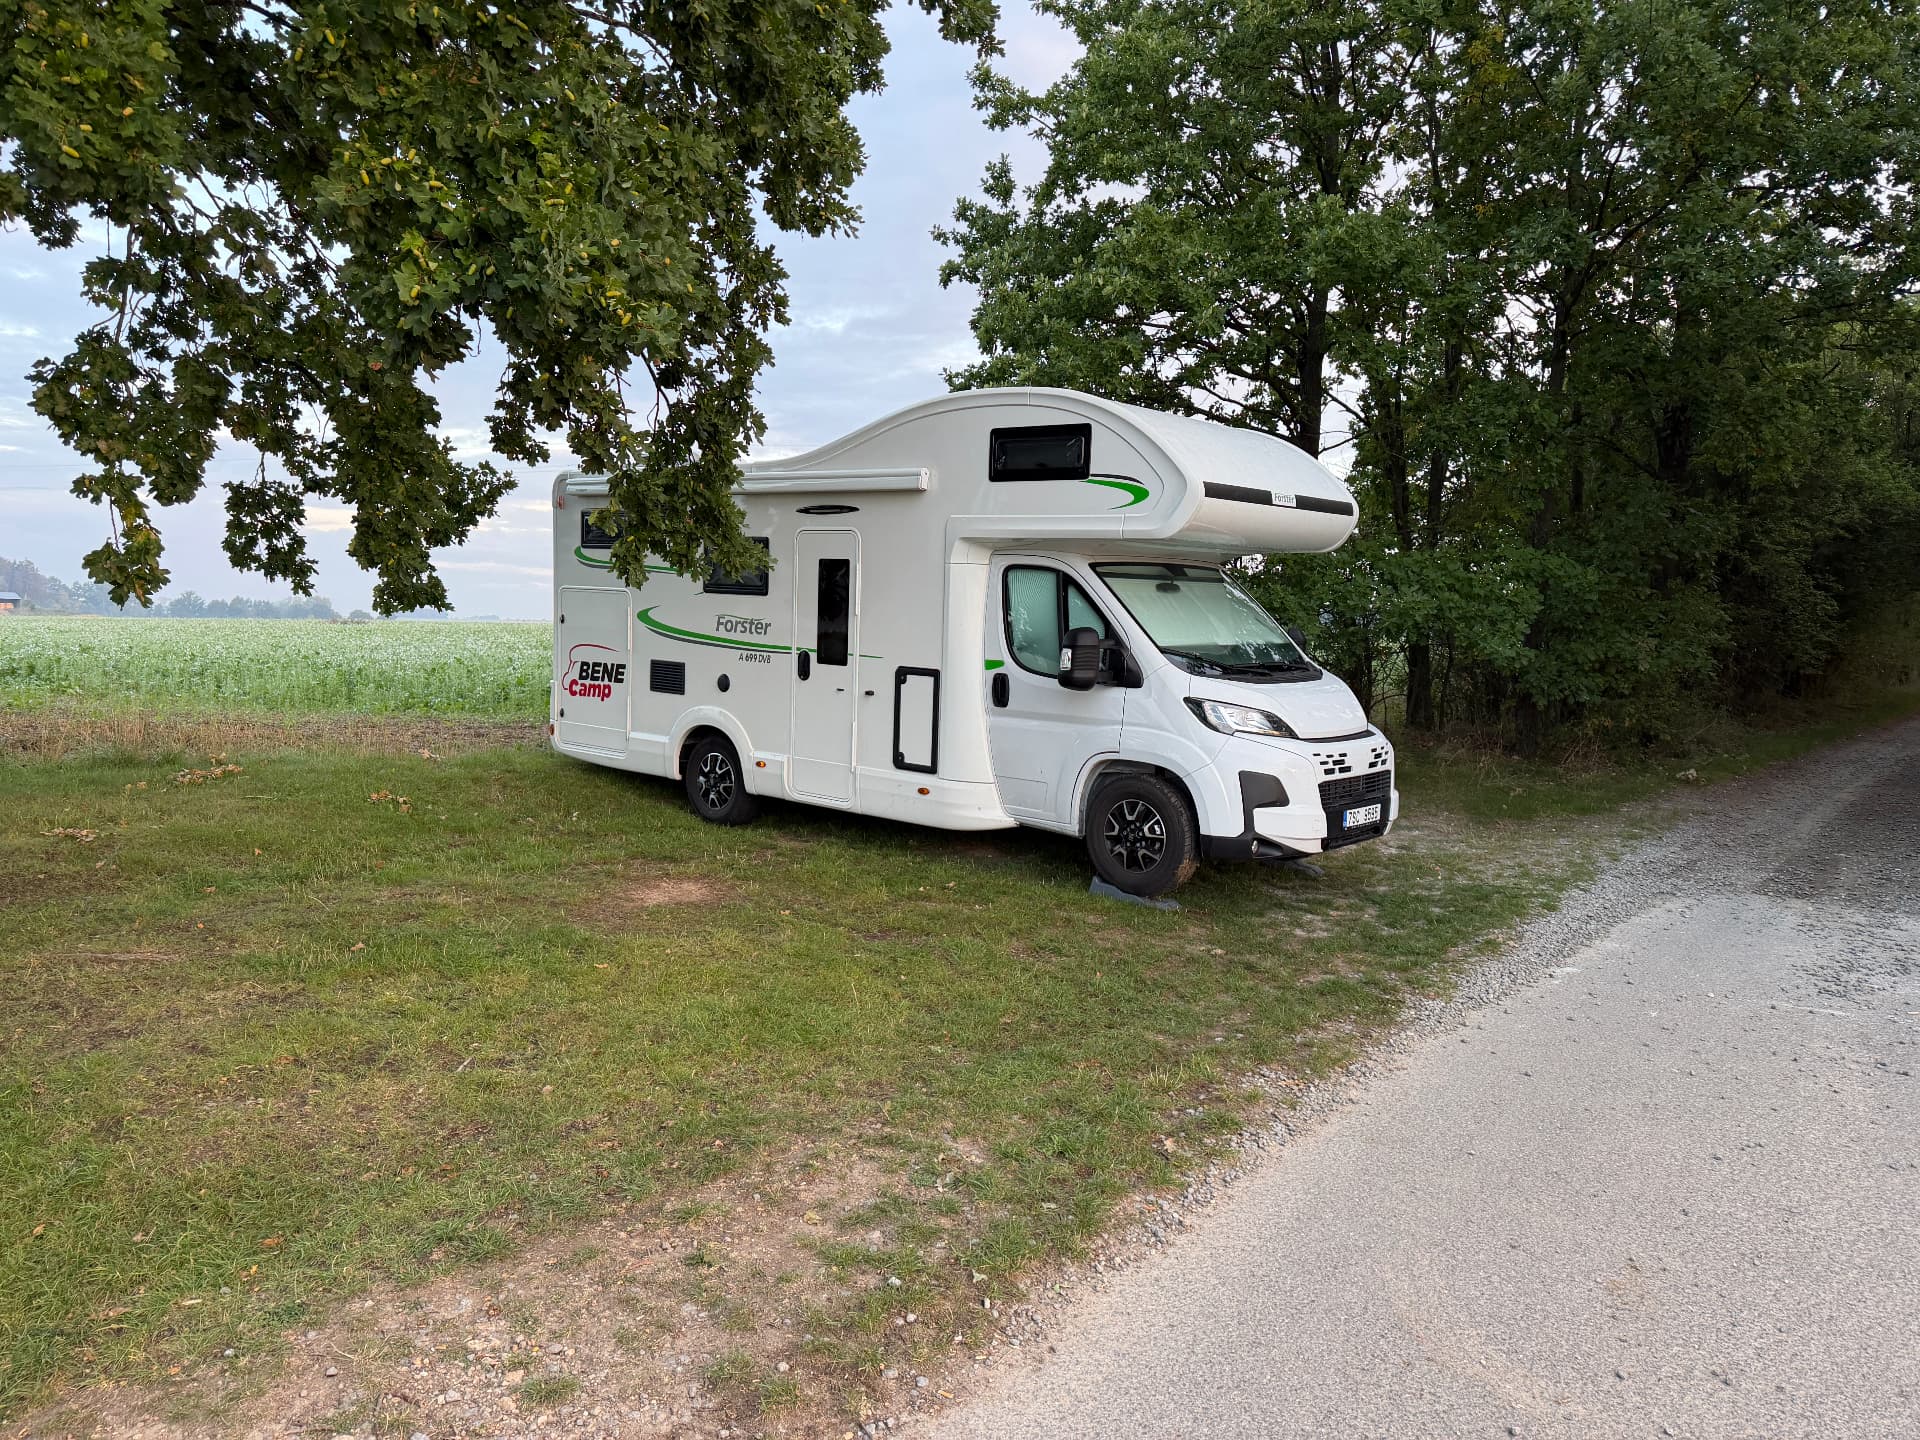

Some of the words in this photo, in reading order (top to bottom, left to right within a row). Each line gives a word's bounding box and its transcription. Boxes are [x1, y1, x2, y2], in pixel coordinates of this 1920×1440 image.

[715, 615, 772, 636] Forster
[738, 652, 744, 662] A
[745, 652, 758, 663] 699
[578, 661, 627, 683] BENE
[569, 679, 612, 701] Camp
